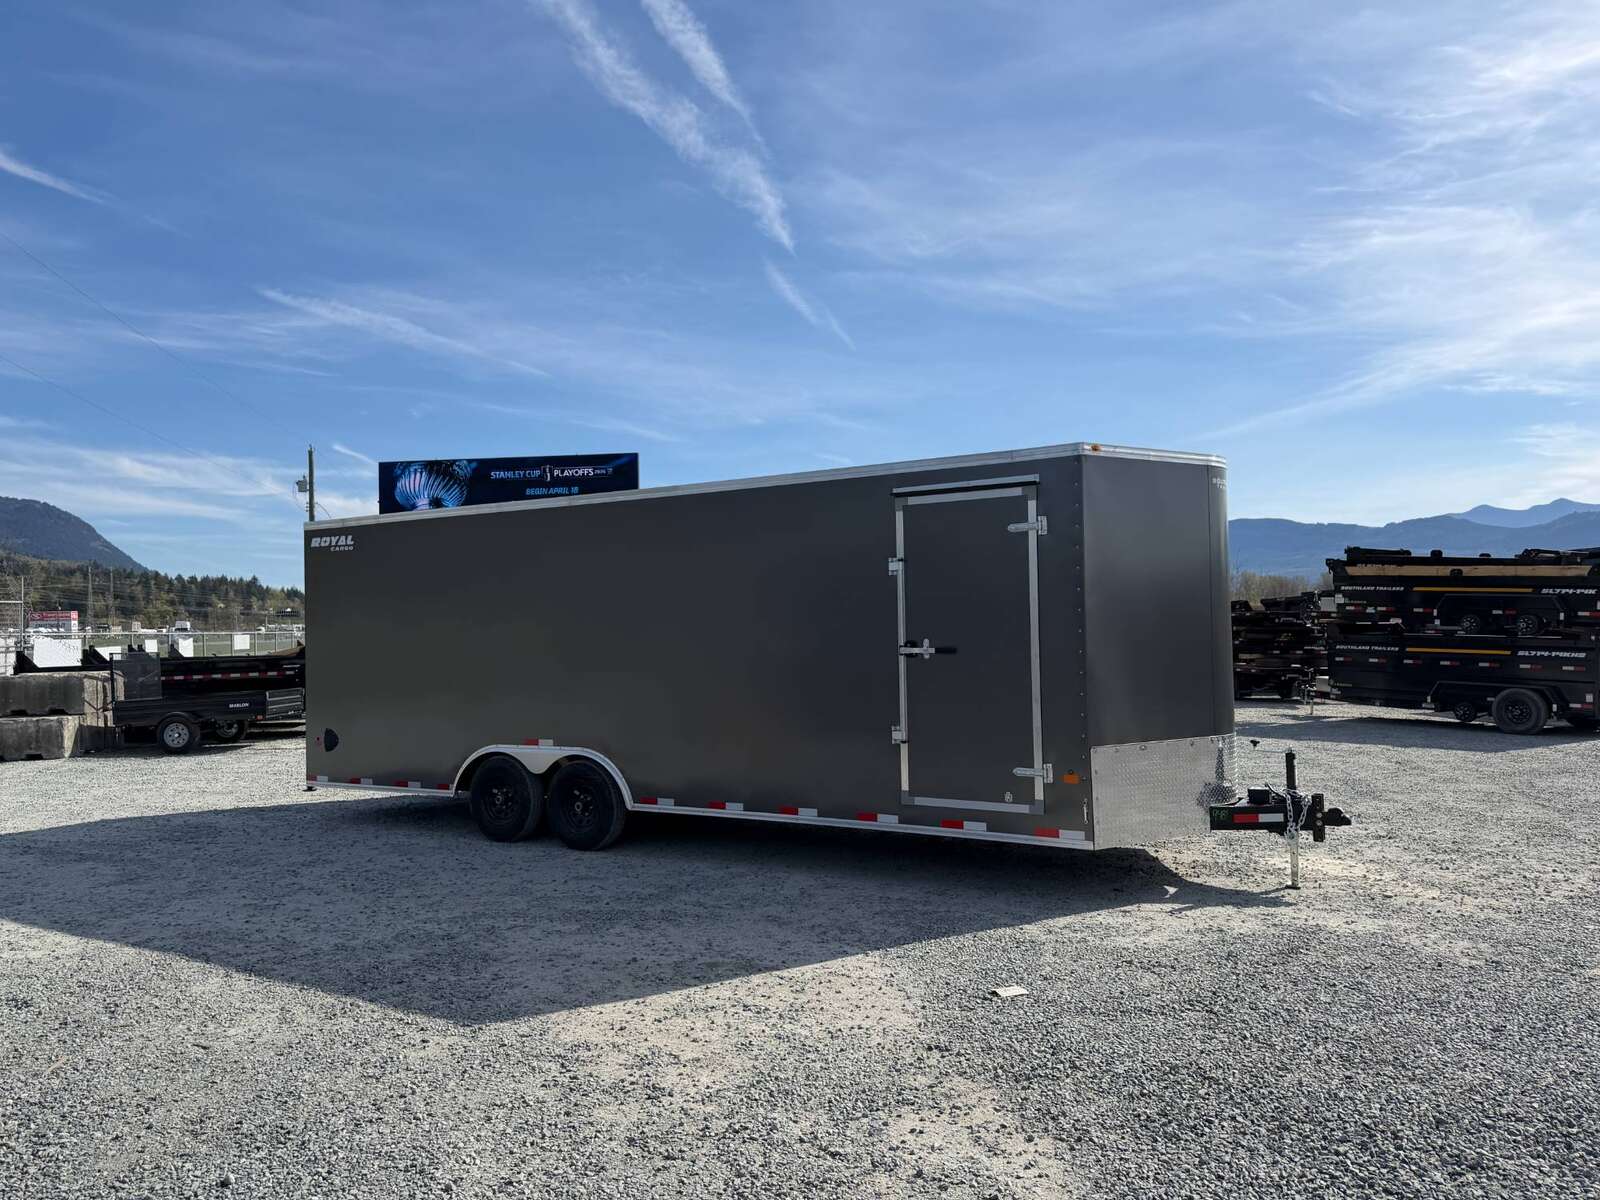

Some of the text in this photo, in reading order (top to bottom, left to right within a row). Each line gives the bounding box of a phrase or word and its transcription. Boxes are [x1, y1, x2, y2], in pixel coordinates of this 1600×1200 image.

[490, 471, 525, 479] STANLEY
[526, 469, 541, 478] CUP
[554, 468, 594, 477] PLAYOFFS
[548, 487, 570, 495] APRIL
[311, 535, 354, 547] ROYAL
